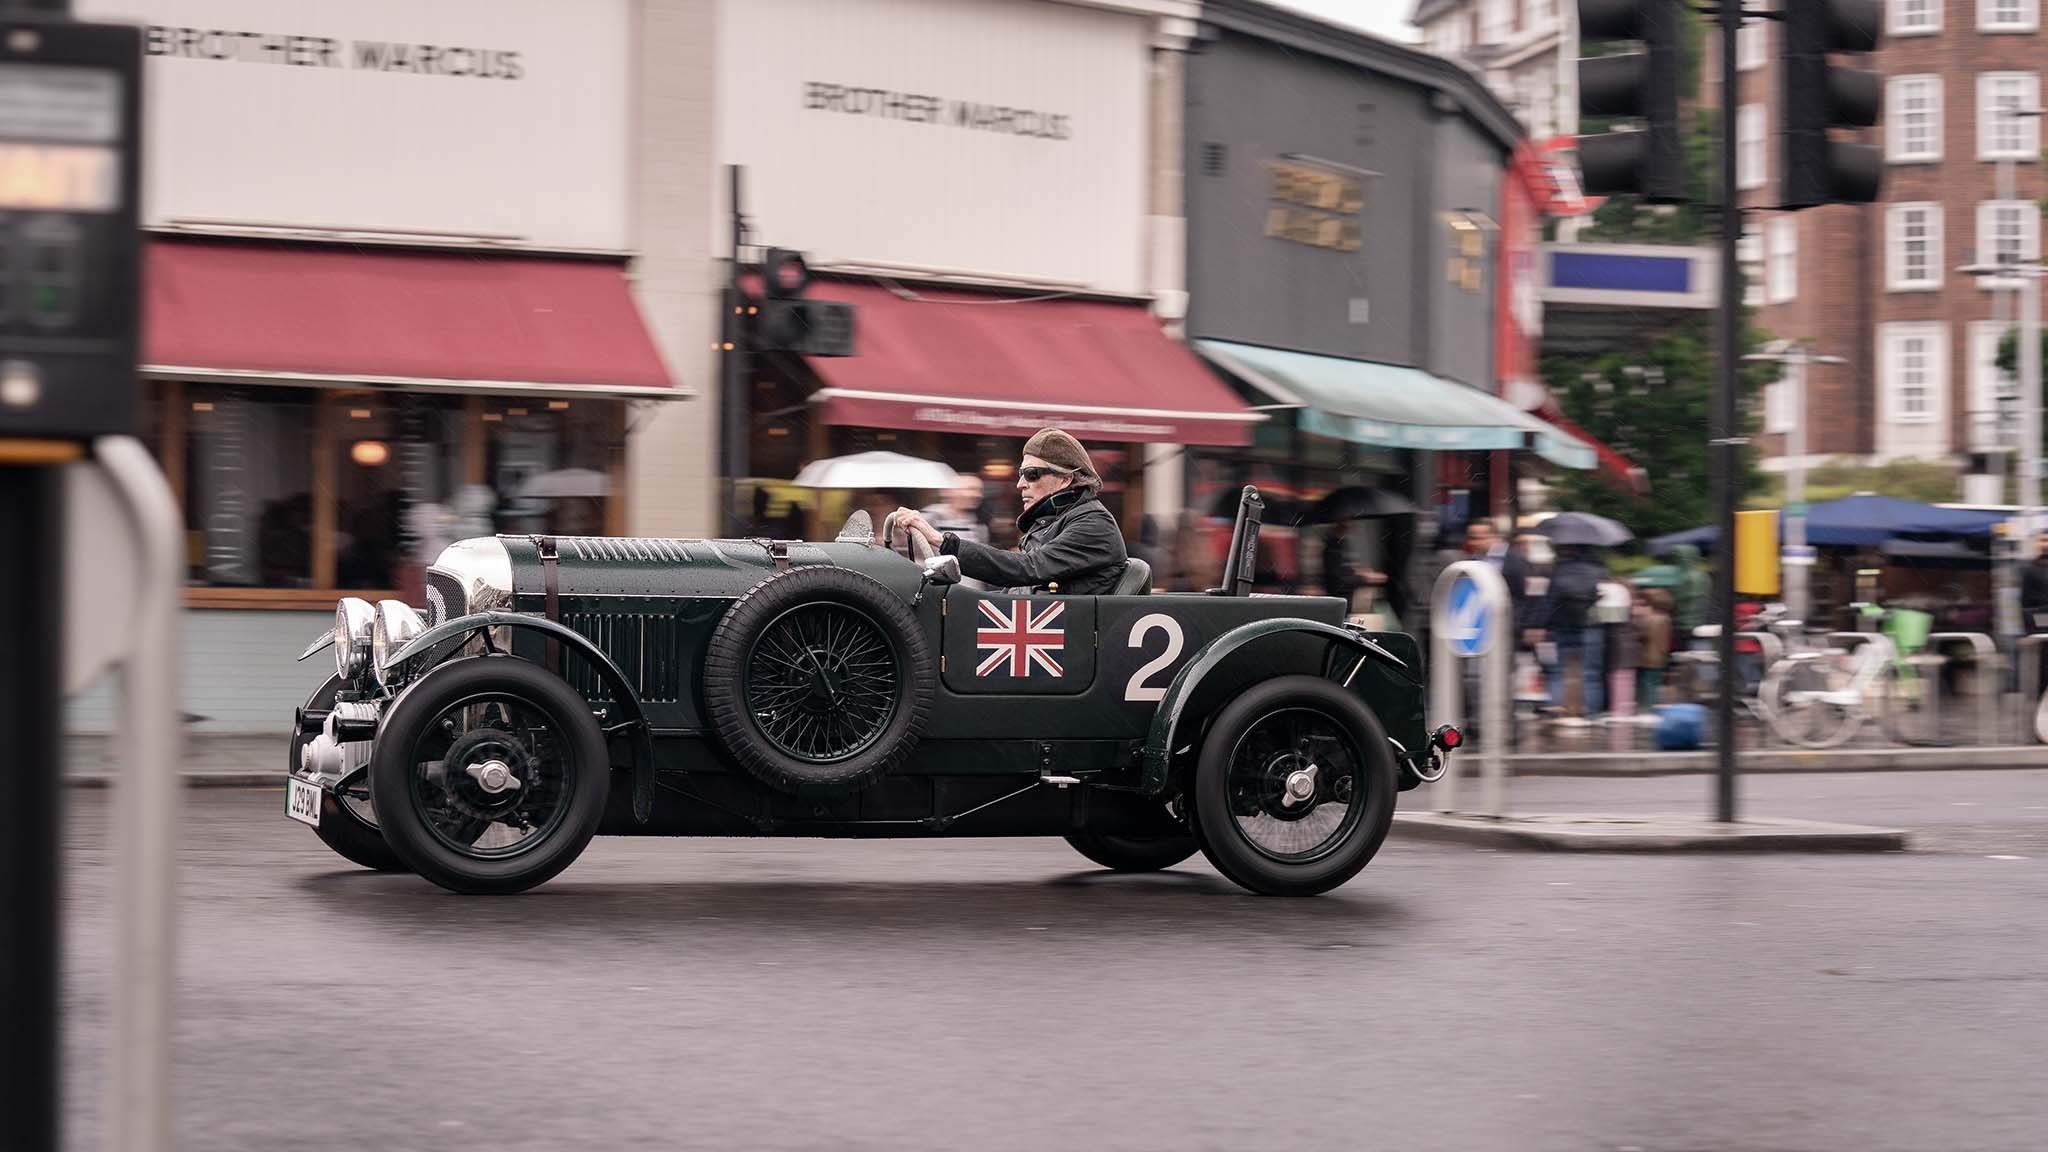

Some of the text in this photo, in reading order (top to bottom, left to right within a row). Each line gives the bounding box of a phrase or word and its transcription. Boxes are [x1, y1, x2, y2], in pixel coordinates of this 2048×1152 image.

[145, 25, 343, 69] BROTHER
[803, 81, 940, 125] BROTHER
[1125, 614, 1184, 701] 2
